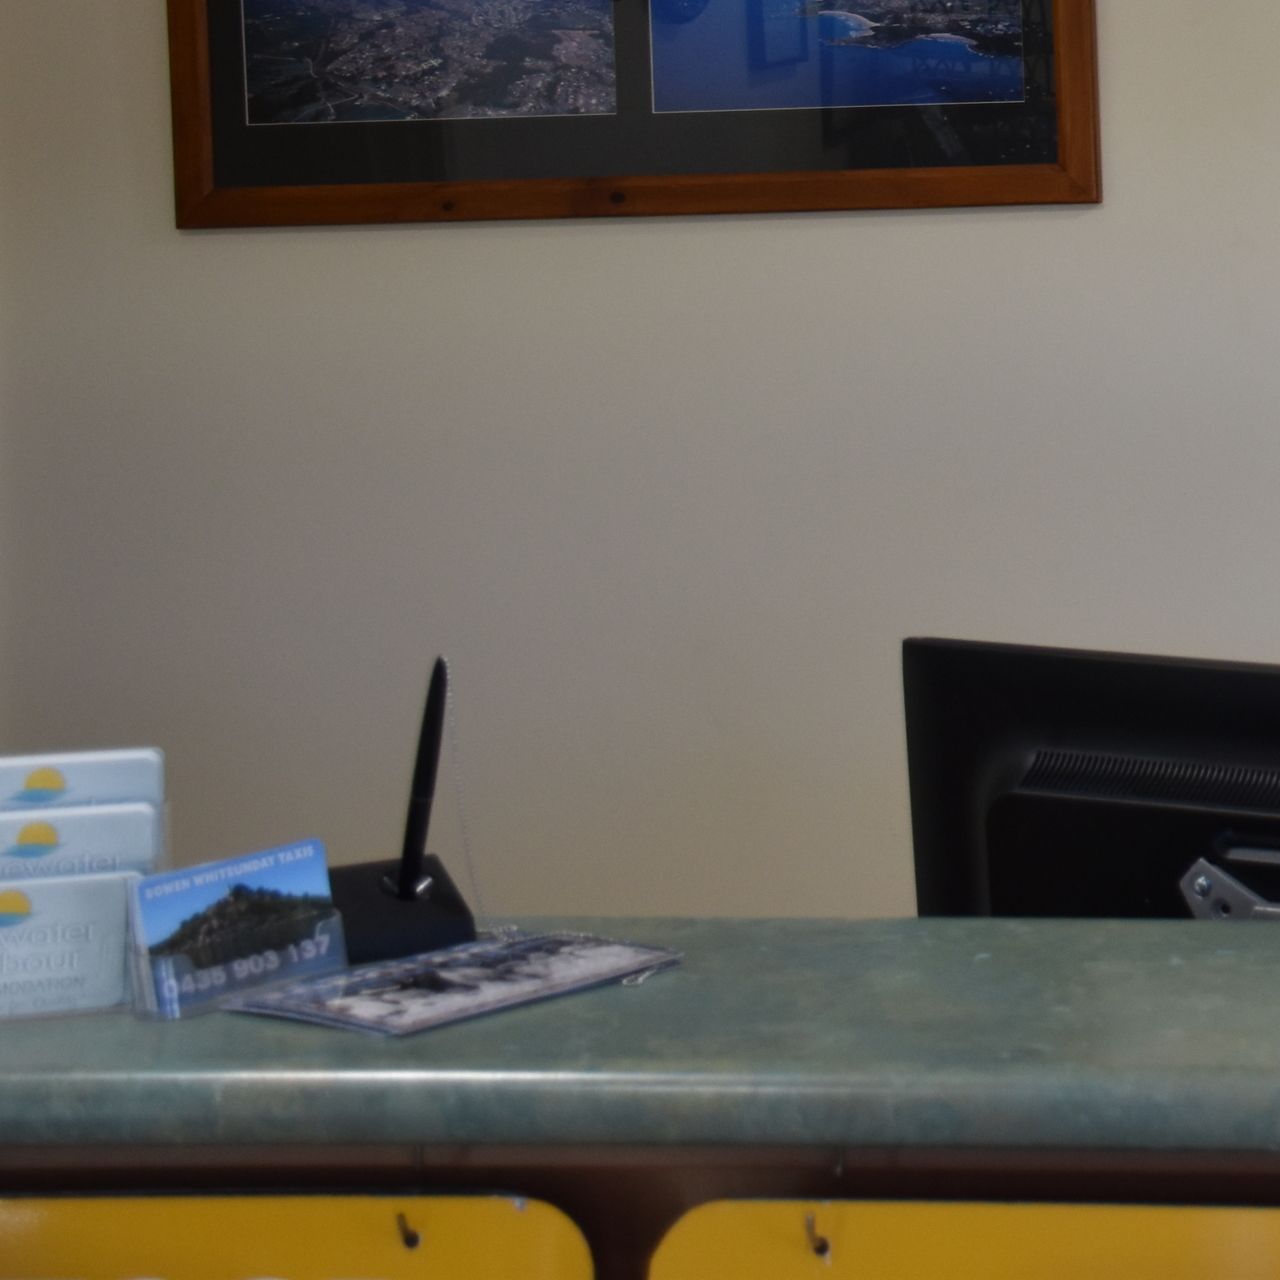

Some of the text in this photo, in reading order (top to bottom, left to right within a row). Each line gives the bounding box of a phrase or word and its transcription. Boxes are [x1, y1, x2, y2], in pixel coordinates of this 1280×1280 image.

[145, 844, 314, 899] BOWEN WHITSUNDAY TAXIS
[233, 949, 280, 979] 903
[289, 933, 331, 963] 137
